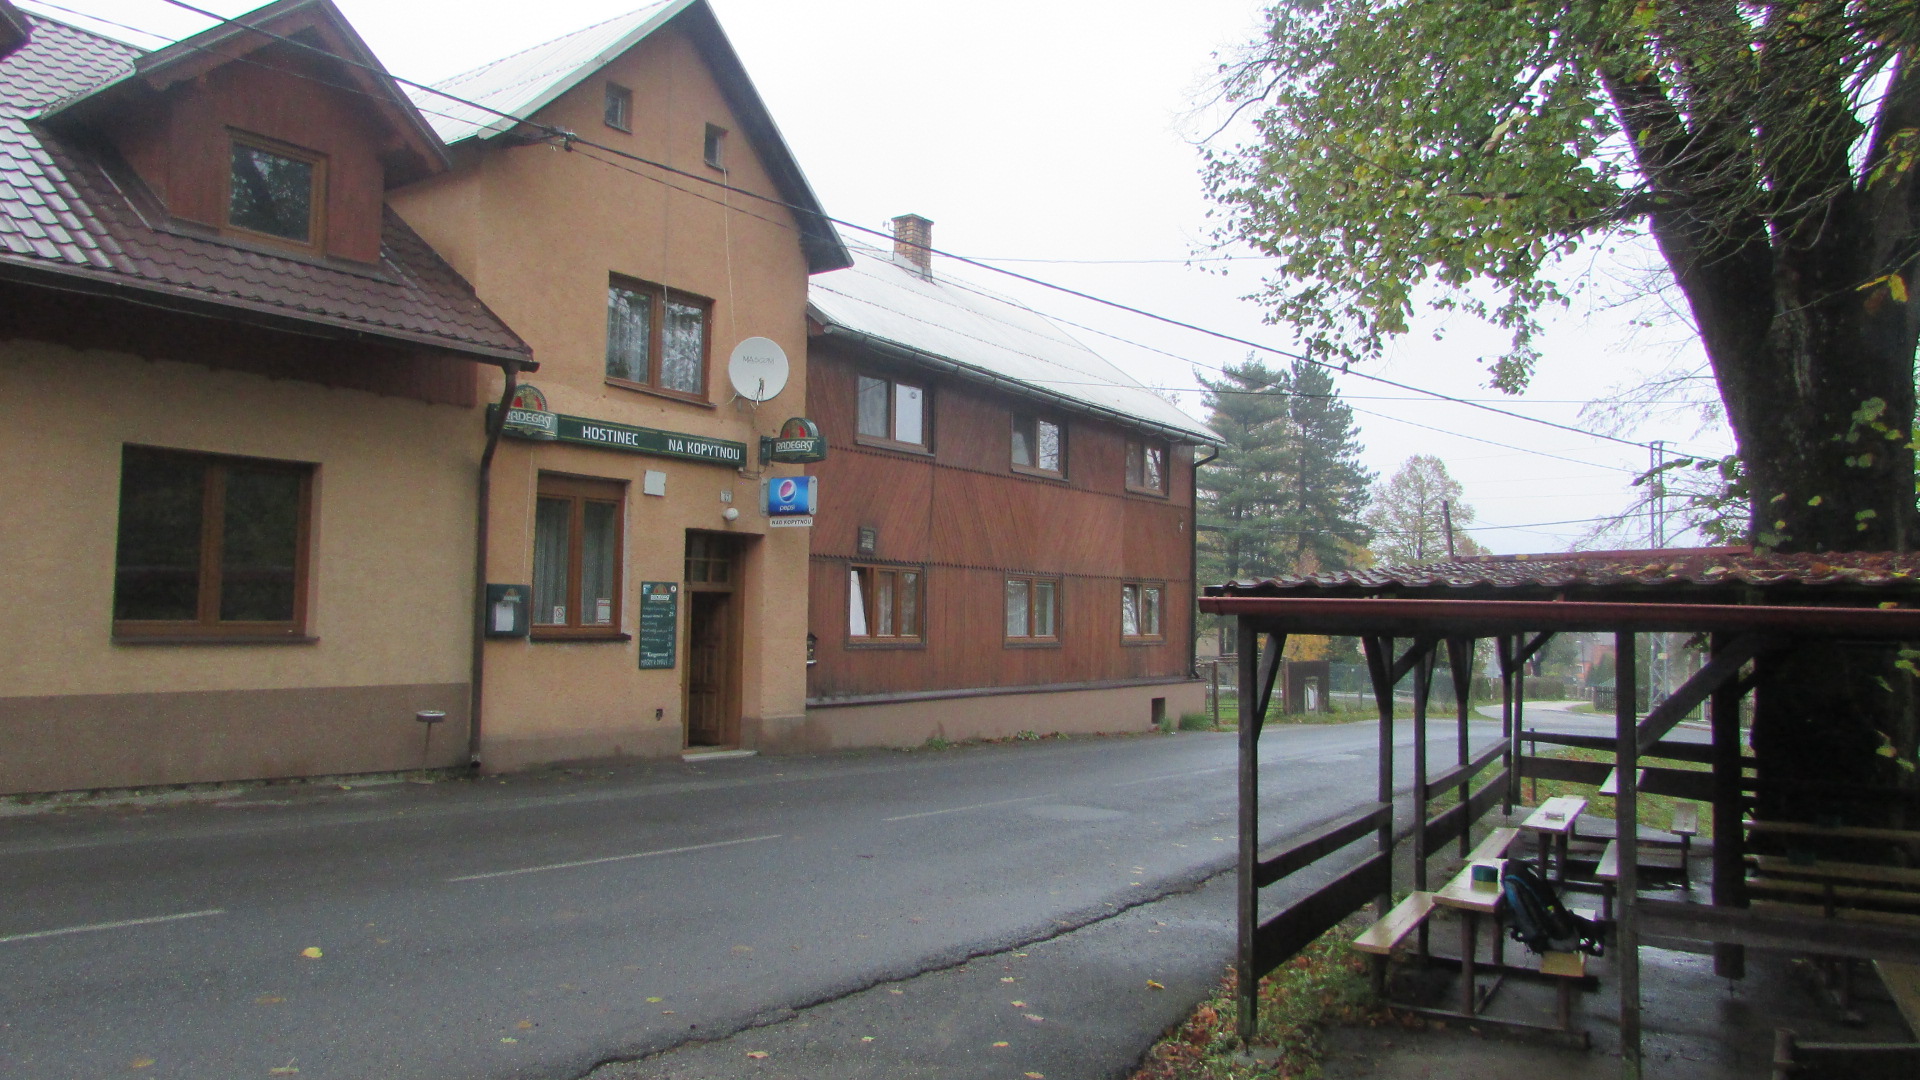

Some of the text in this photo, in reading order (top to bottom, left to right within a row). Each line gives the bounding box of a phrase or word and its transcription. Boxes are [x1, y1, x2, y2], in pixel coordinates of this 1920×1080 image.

[582, 425, 740, 460] HOSTINEC NA KOPYTNOU
[775, 440, 815, 453] RADEGAST
[779, 504, 796, 512] pepsi
